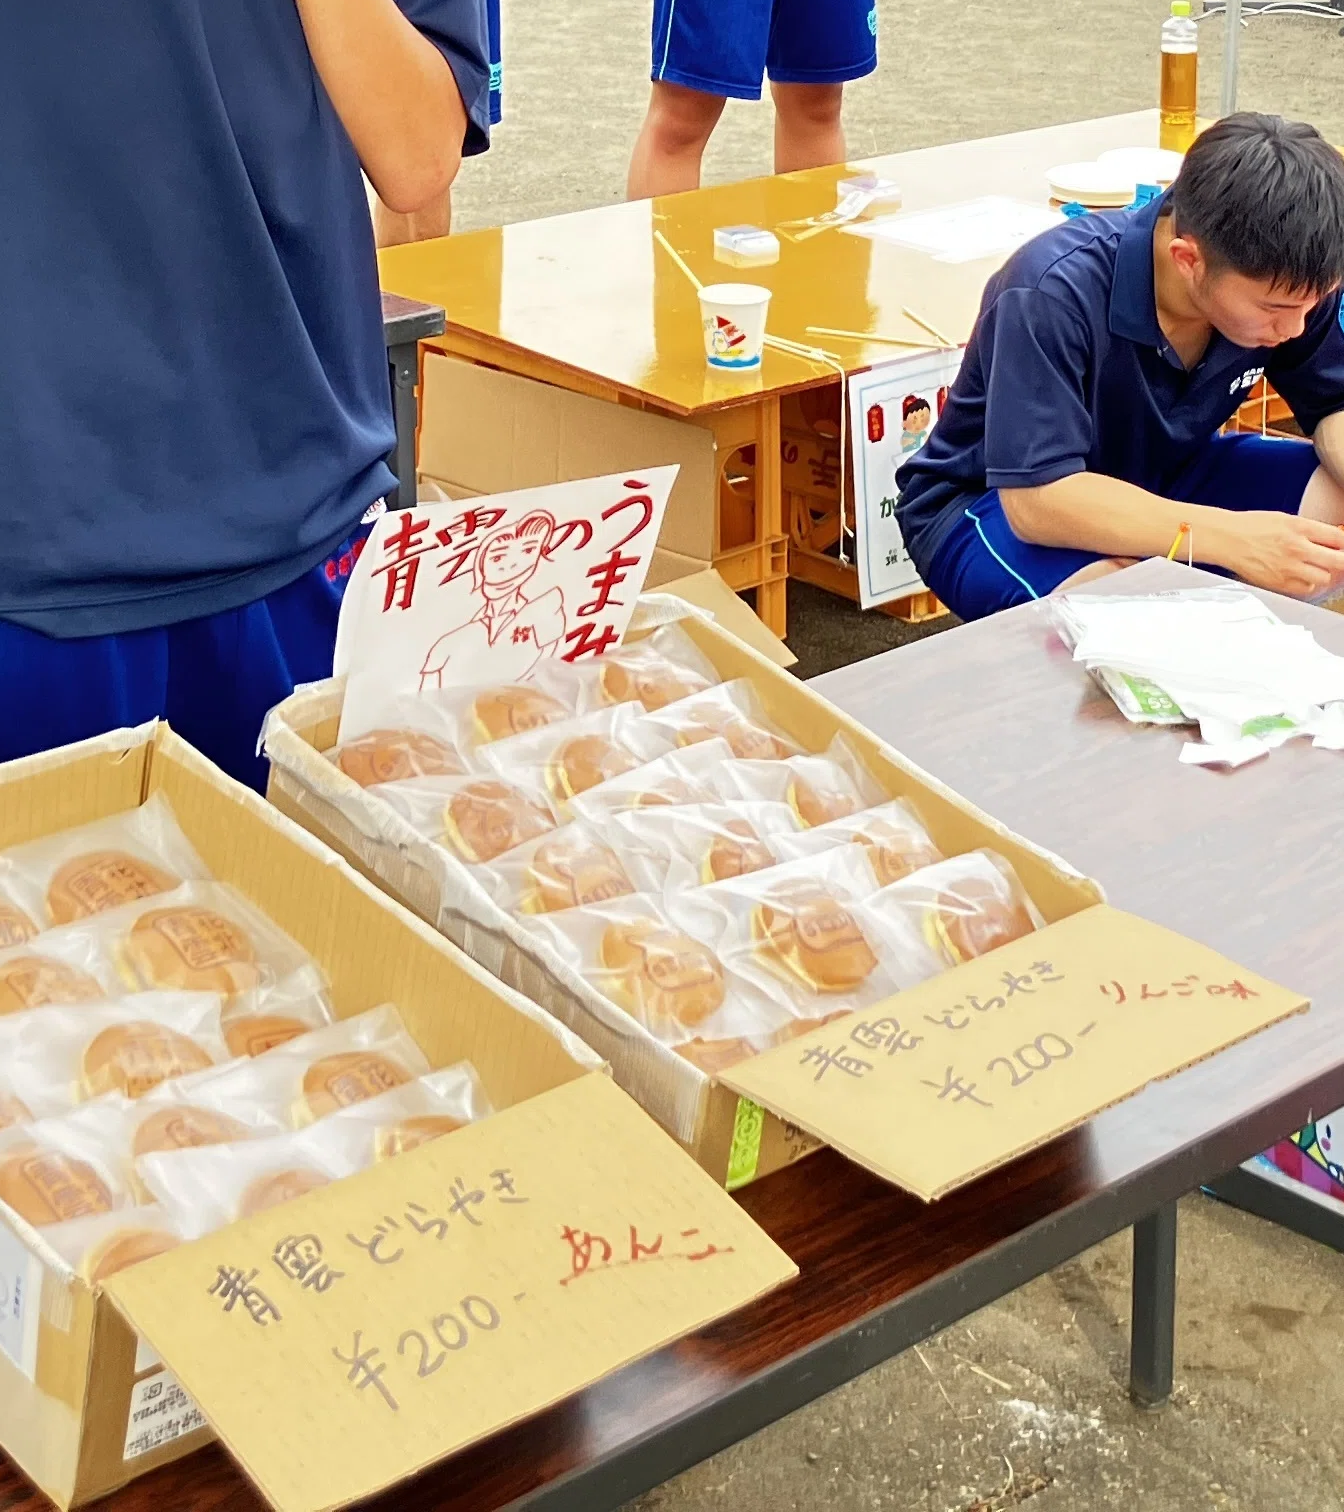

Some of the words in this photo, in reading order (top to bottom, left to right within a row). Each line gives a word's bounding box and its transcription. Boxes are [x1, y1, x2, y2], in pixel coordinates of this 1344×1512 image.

[560, 479, 654, 663] うまみ
[1100, 974, 1261, 1006] りんご味
[558, 1224, 735, 1280] あんこ
